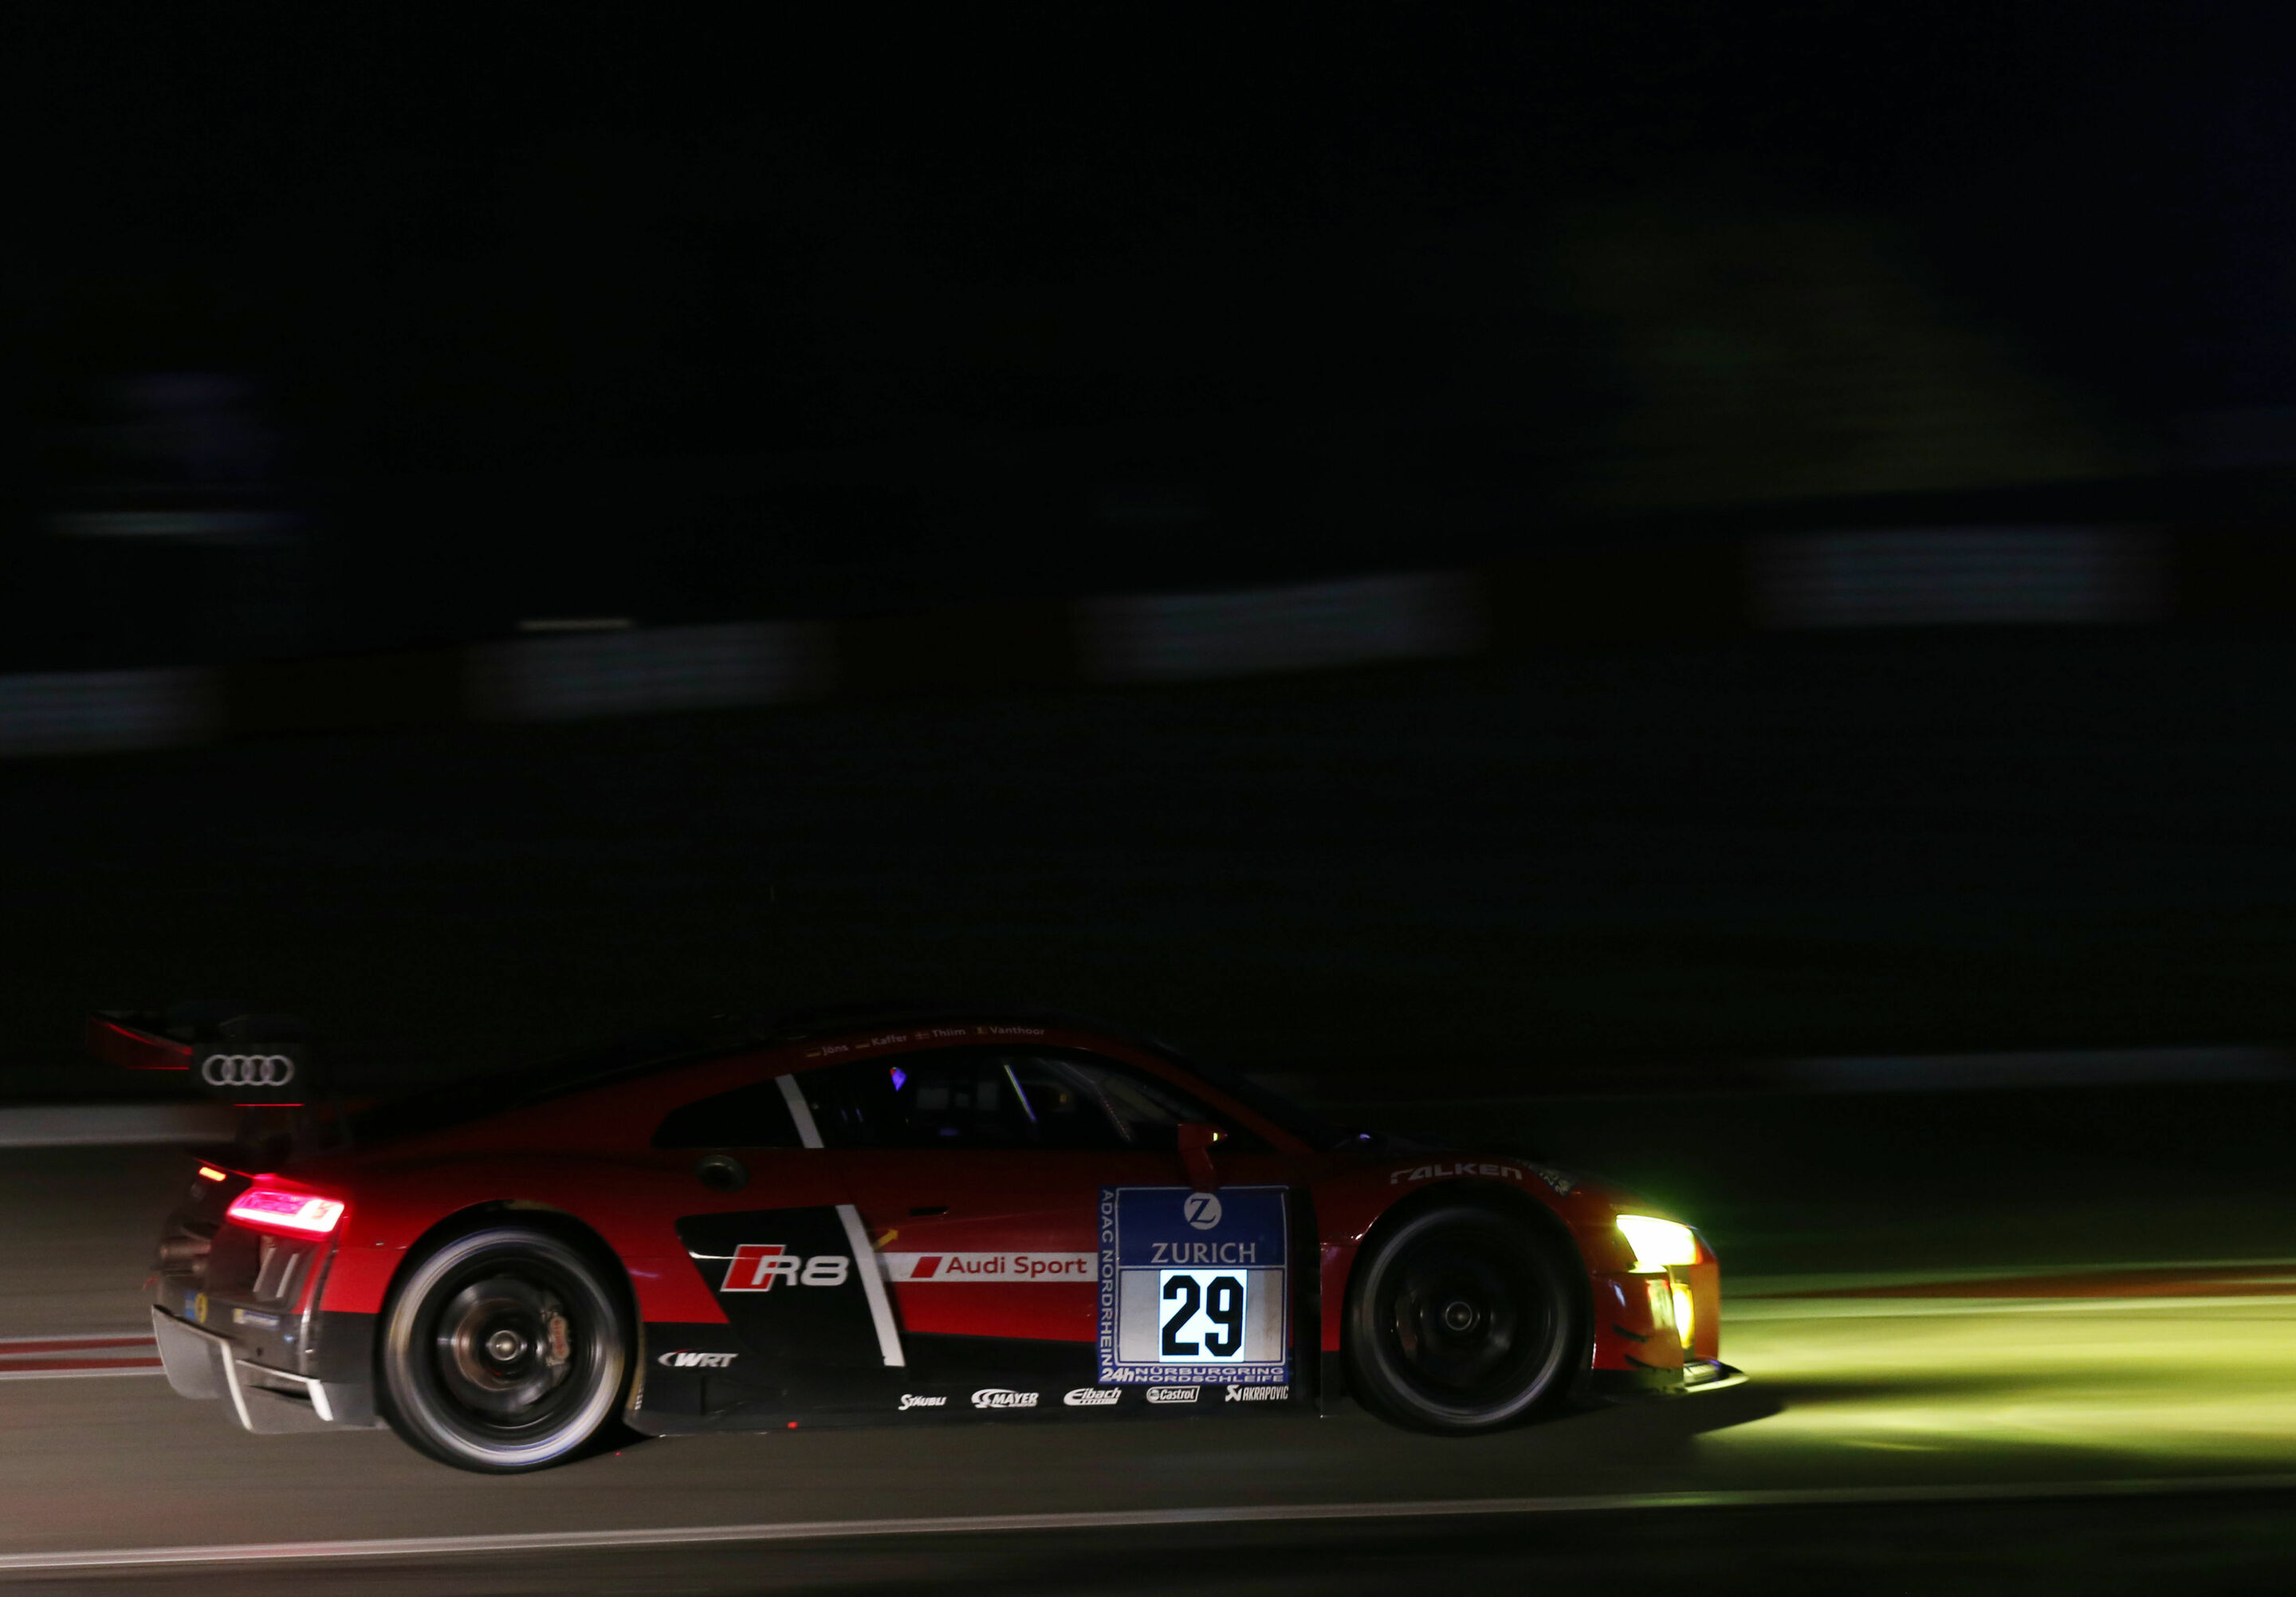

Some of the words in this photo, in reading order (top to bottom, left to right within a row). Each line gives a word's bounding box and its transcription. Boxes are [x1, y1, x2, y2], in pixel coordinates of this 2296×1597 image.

[871, 1034, 907, 1046] Kaffer
[989, 1025, 1045, 1036] Vanthoor
[1390, 1162, 1523, 1185] FALKEN
[1101, 1190, 1114, 1243] ADAC
[1150, 1242, 1256, 1264] ZURICH
[749, 1254, 851, 1287] R8
[946, 1257, 1005, 1274] Audi
[1014, 1257, 1087, 1278] Sport
[1099, 1250, 1114, 1367] NORDRHEIN
[1162, 1275, 1244, 1356] 29
[674, 1352, 739, 1367] WRT
[1099, 1367, 1135, 1383] 24h
[1063, 1387, 1122, 1406] Eibach
[1160, 1389, 1196, 1400] Castrol
